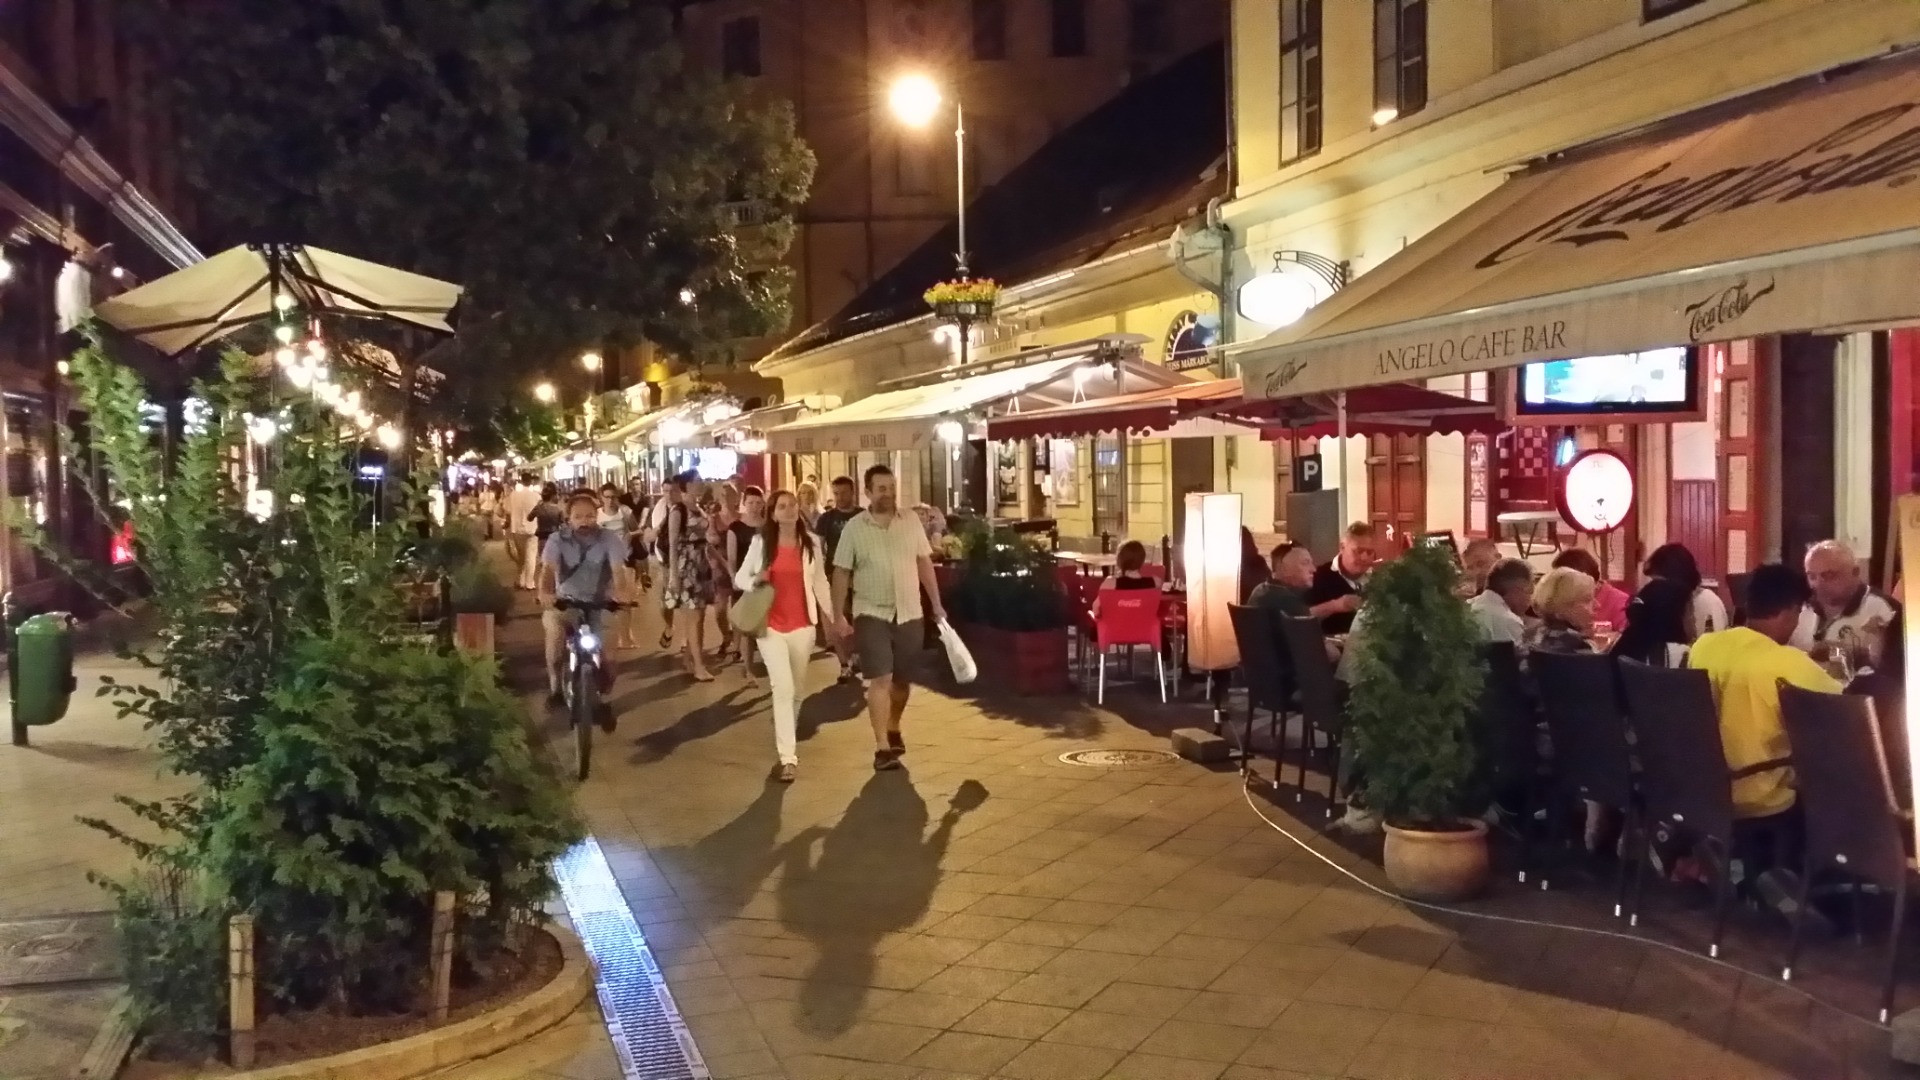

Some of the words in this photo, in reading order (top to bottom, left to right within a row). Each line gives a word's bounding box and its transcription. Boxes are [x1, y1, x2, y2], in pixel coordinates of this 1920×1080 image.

[1374, 340, 1454, 375] ANGELO
[1460, 328, 1516, 361] CAFE
[1522, 320, 1566, 353] BAR
[1303, 461, 1318, 481] P
